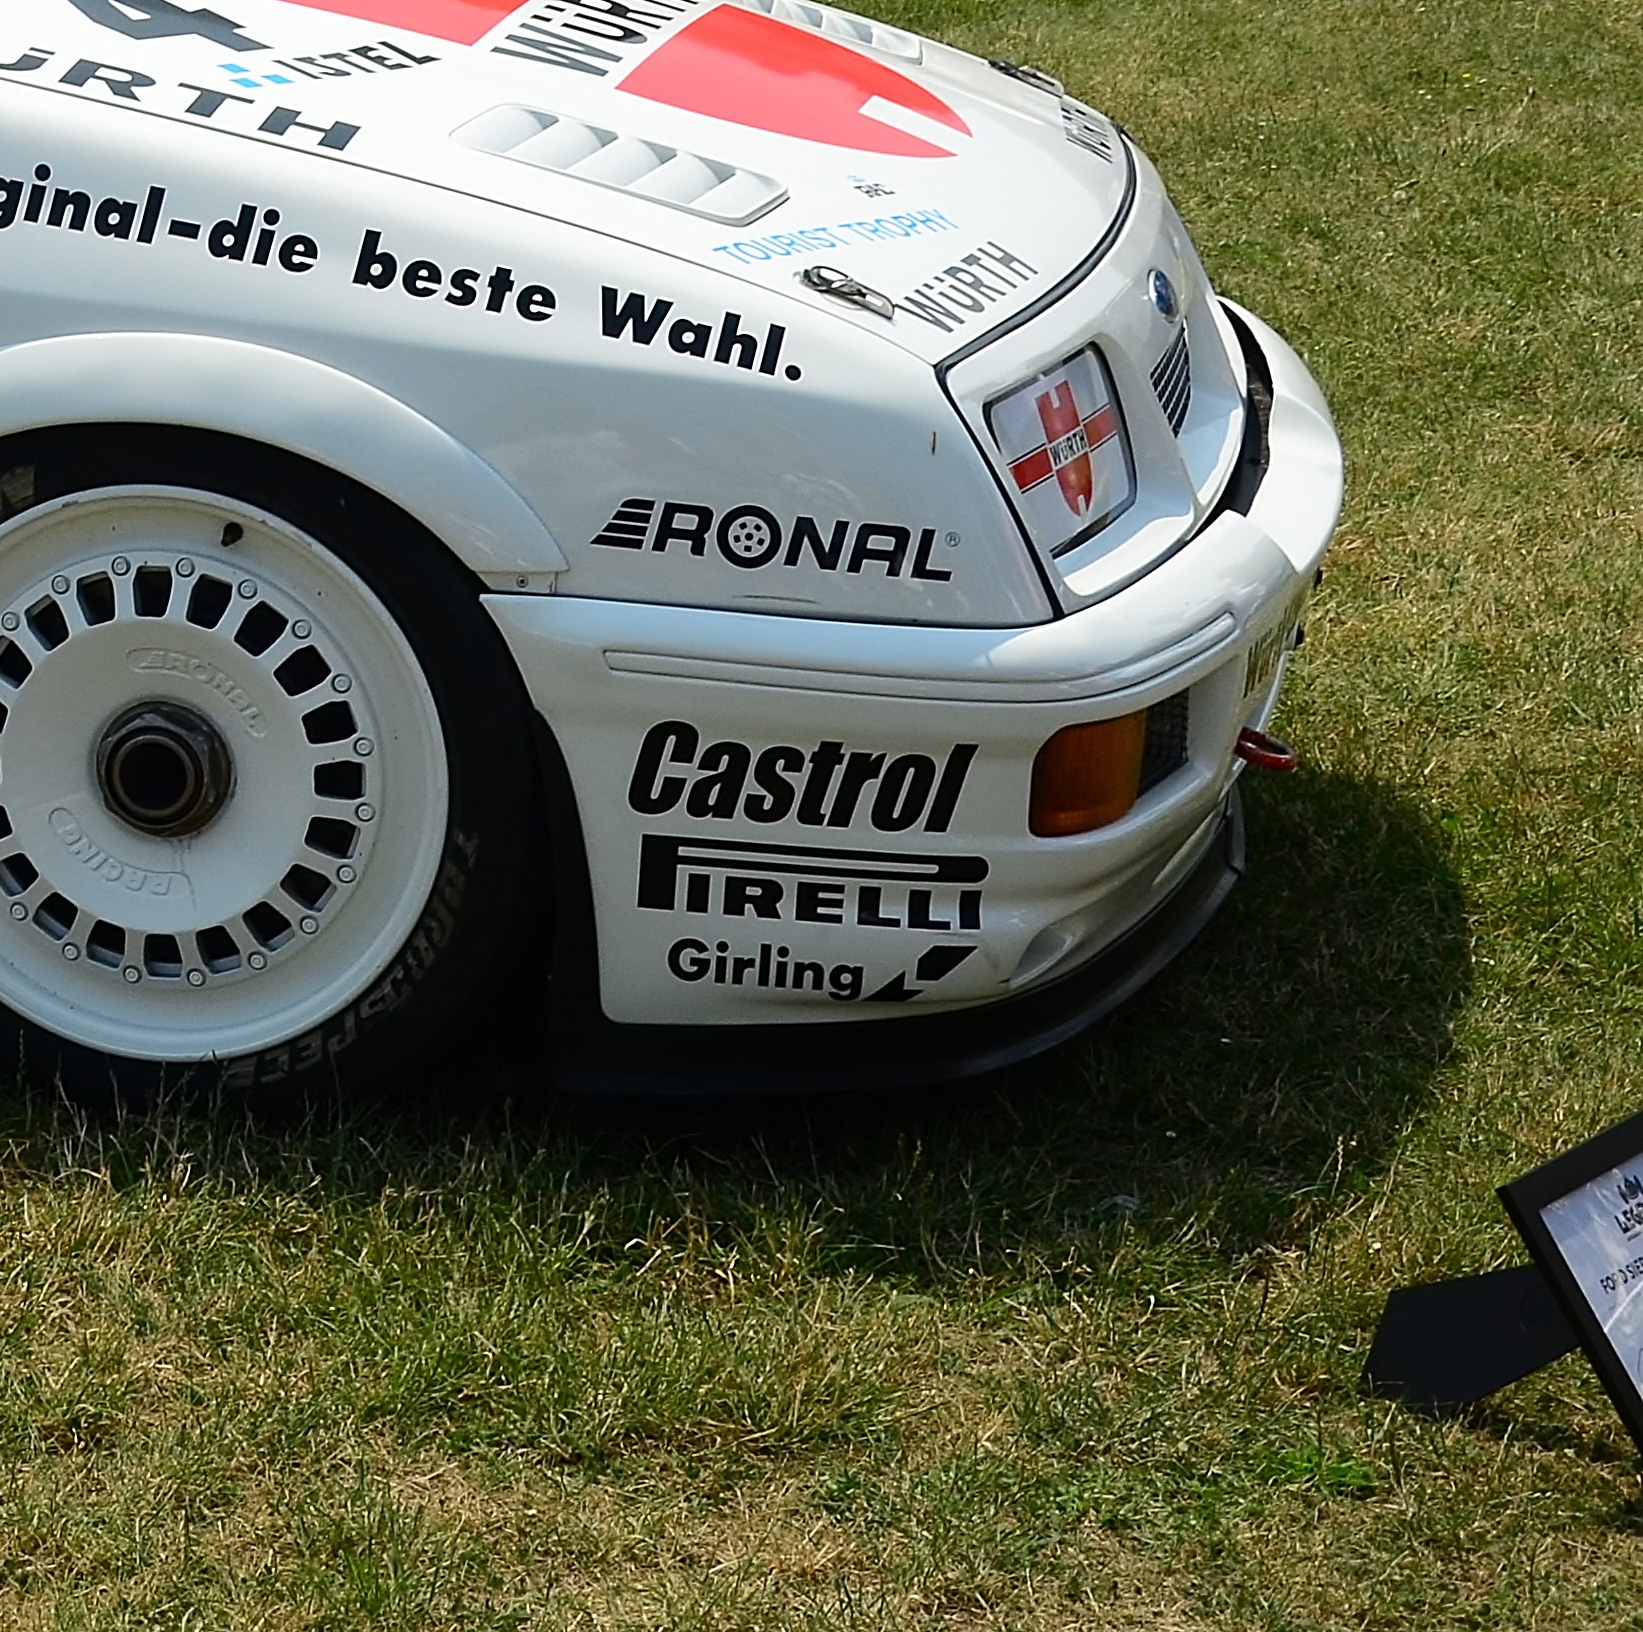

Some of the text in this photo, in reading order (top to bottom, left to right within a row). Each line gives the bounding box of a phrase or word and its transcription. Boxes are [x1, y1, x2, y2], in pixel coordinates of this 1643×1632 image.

[273, 40, 443, 81] ISTEL
[711, 208, 960, 265] TOURIST TROPHY
[352, 228, 558, 324] beste
[601, 284, 805, 383] Wahl.
[893, 240, 1040, 334] WÜRTH
[1049, 428, 1088, 467] WÜRTH
[652, 501, 953, 582] RONAL
[626, 719, 979, 834] Castrol
[636, 832, 990, 931] PIRELLI
[666, 936, 865, 1002] Girling
